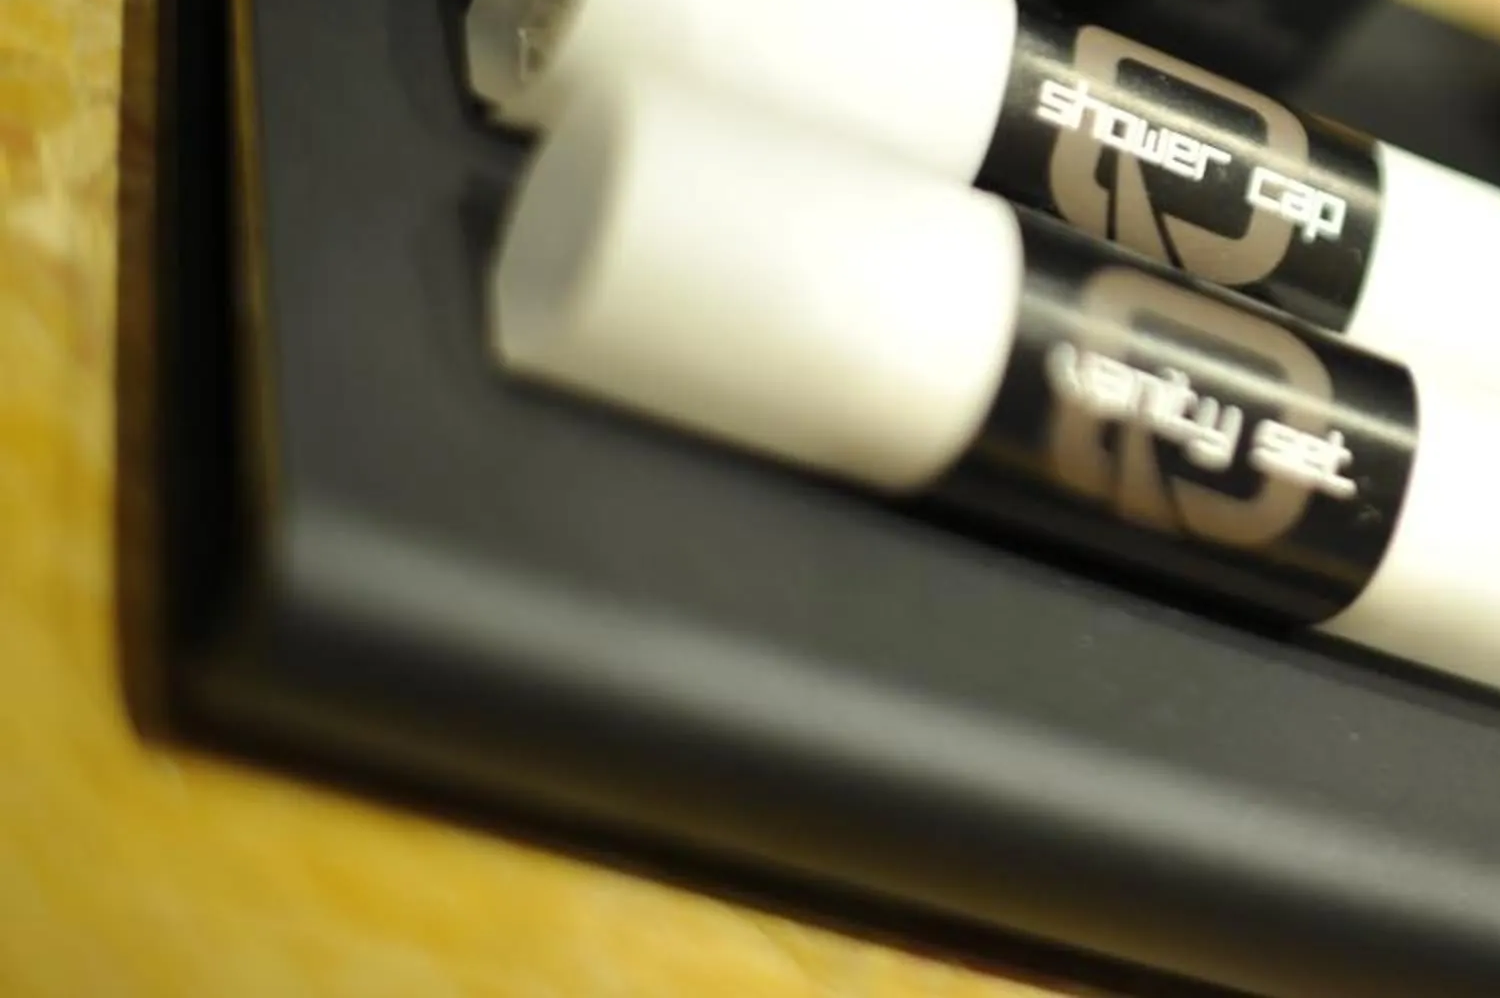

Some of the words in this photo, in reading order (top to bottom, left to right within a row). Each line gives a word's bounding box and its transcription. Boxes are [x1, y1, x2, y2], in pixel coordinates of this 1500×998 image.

[1037, 78, 1232, 181] shower
[1246, 165, 1347, 243] cap
[1045, 340, 1244, 471] vanity
[1249, 417, 1358, 499] set
